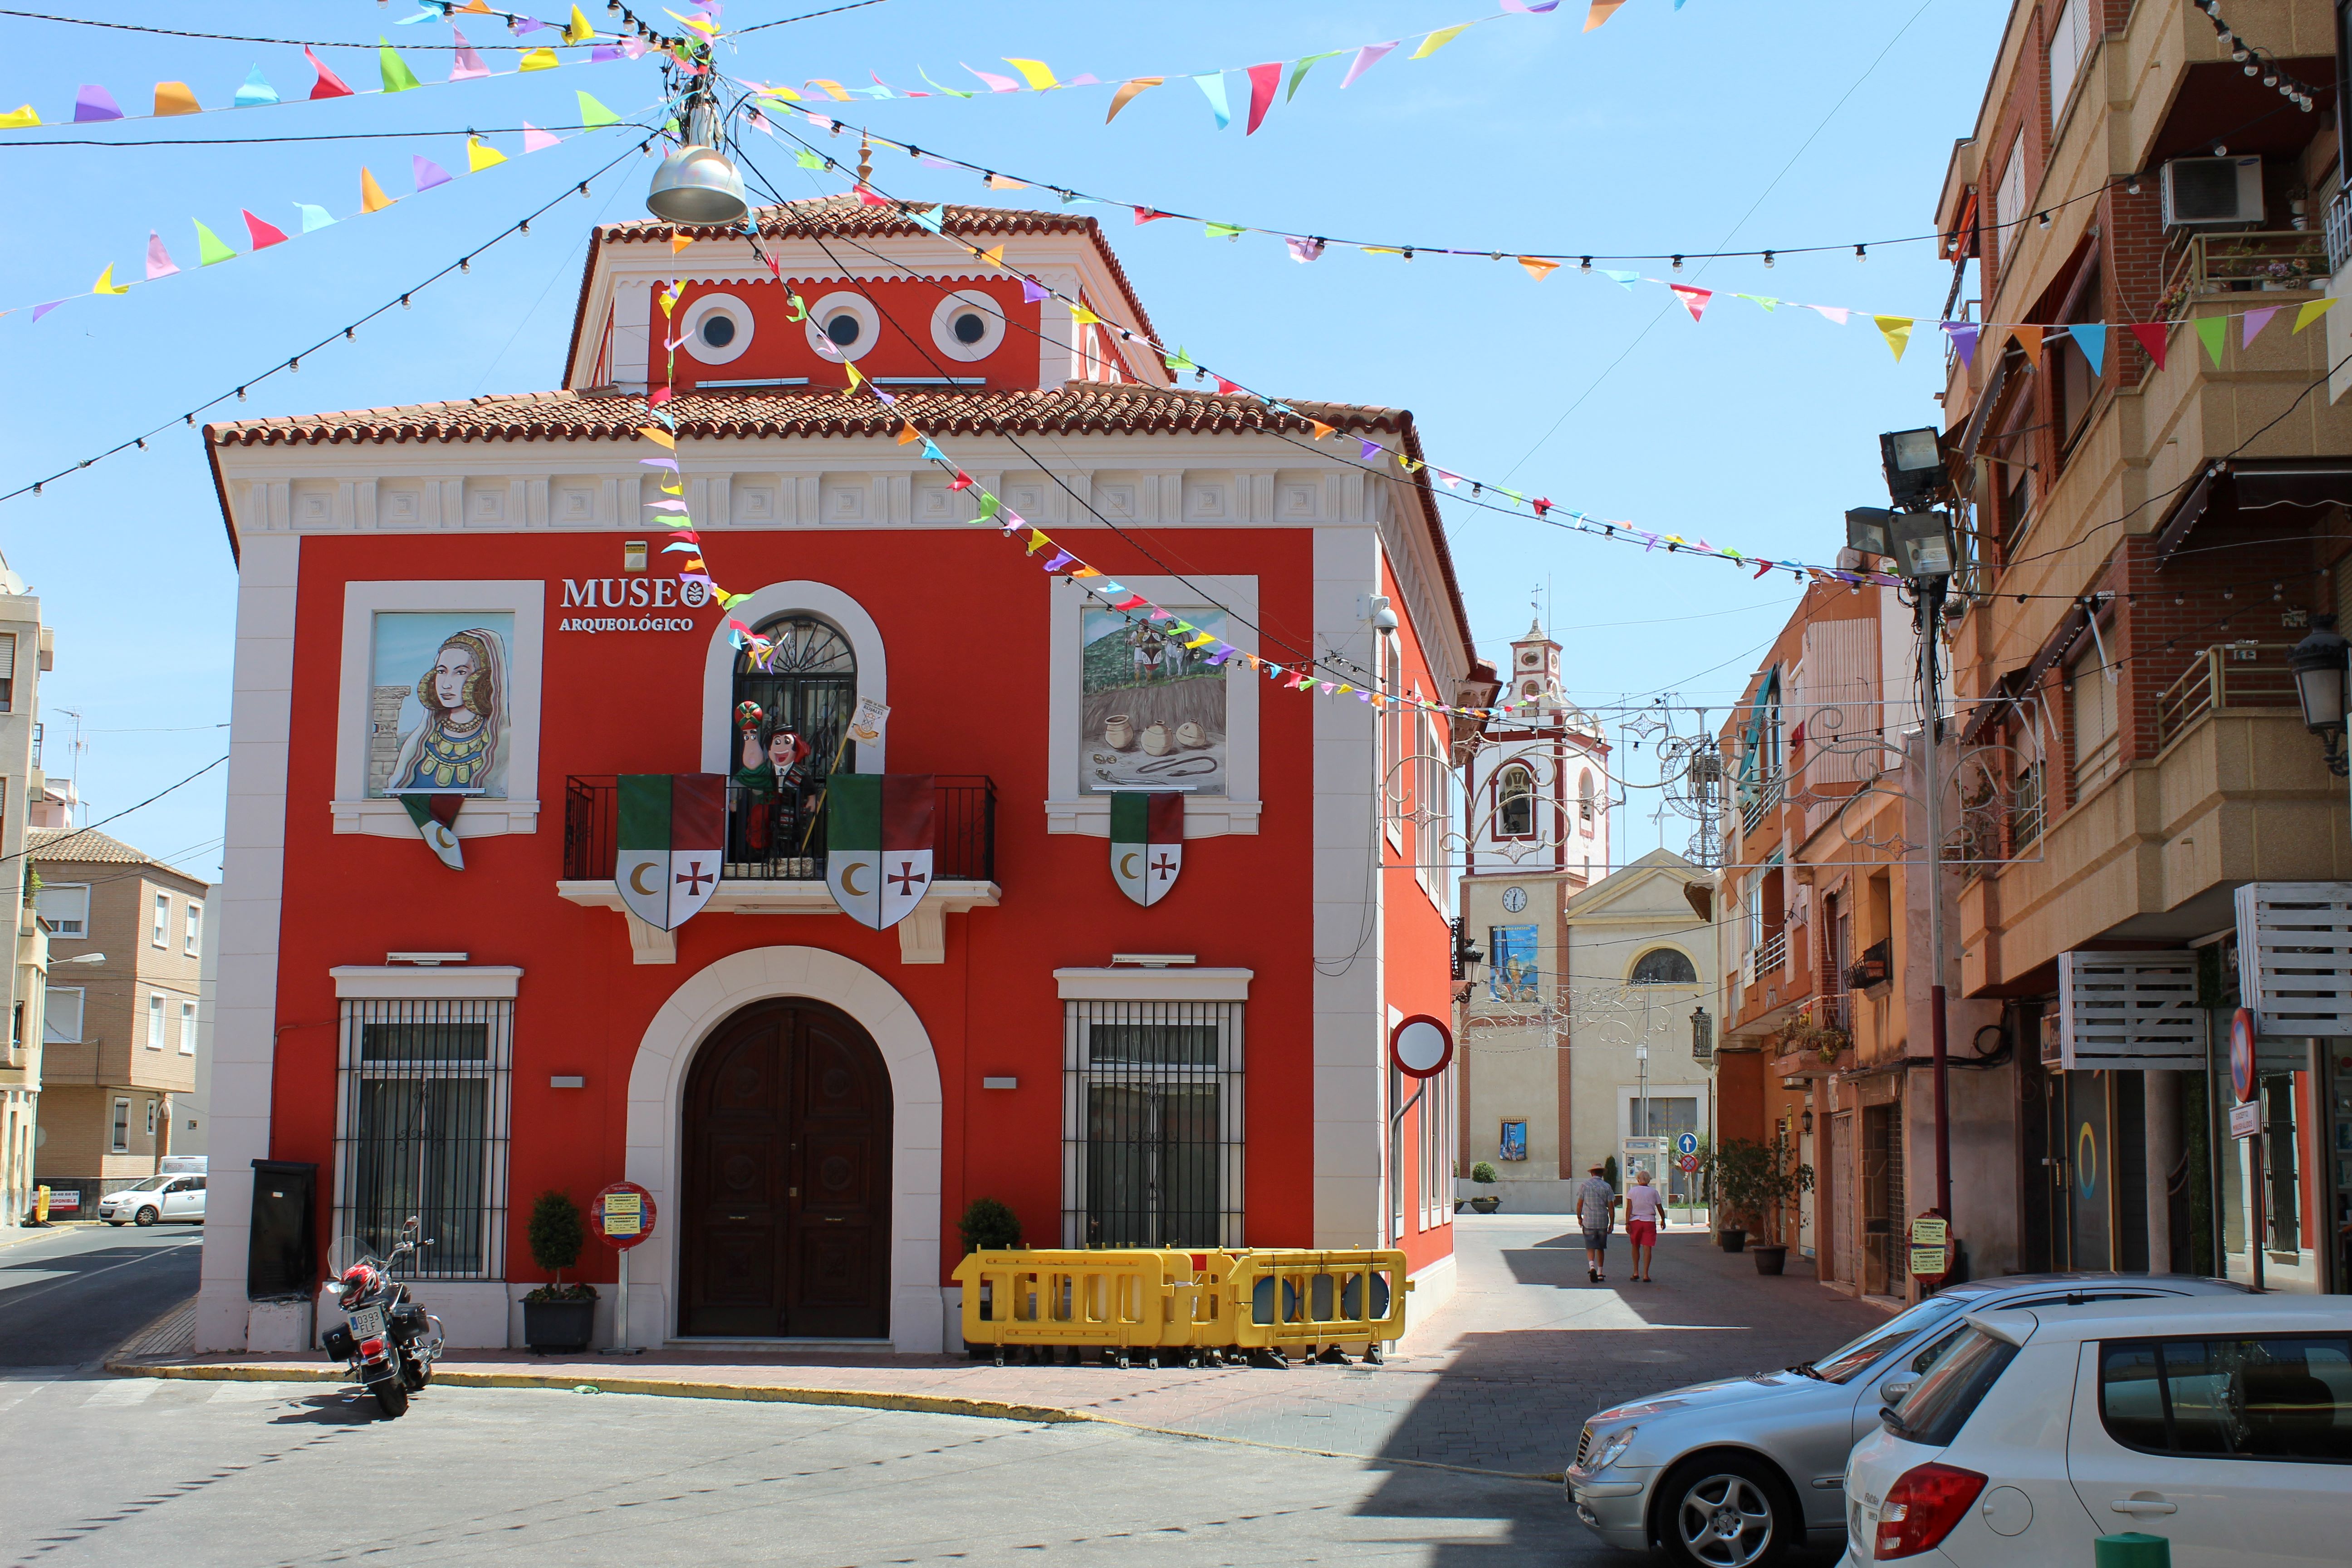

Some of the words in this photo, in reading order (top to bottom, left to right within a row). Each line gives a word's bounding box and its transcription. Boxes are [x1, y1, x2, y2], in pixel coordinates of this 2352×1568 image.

[559, 578, 711, 608] MUSEO
[559, 613, 694, 634] ARQUEOLÓGICO
[863, 704, 883, 715] ROJALES
[2235, 1110, 2249, 1120] EXCEPTO
[357, 1312, 379, 1324] 0393
[360, 1321, 376, 1333] FLF
